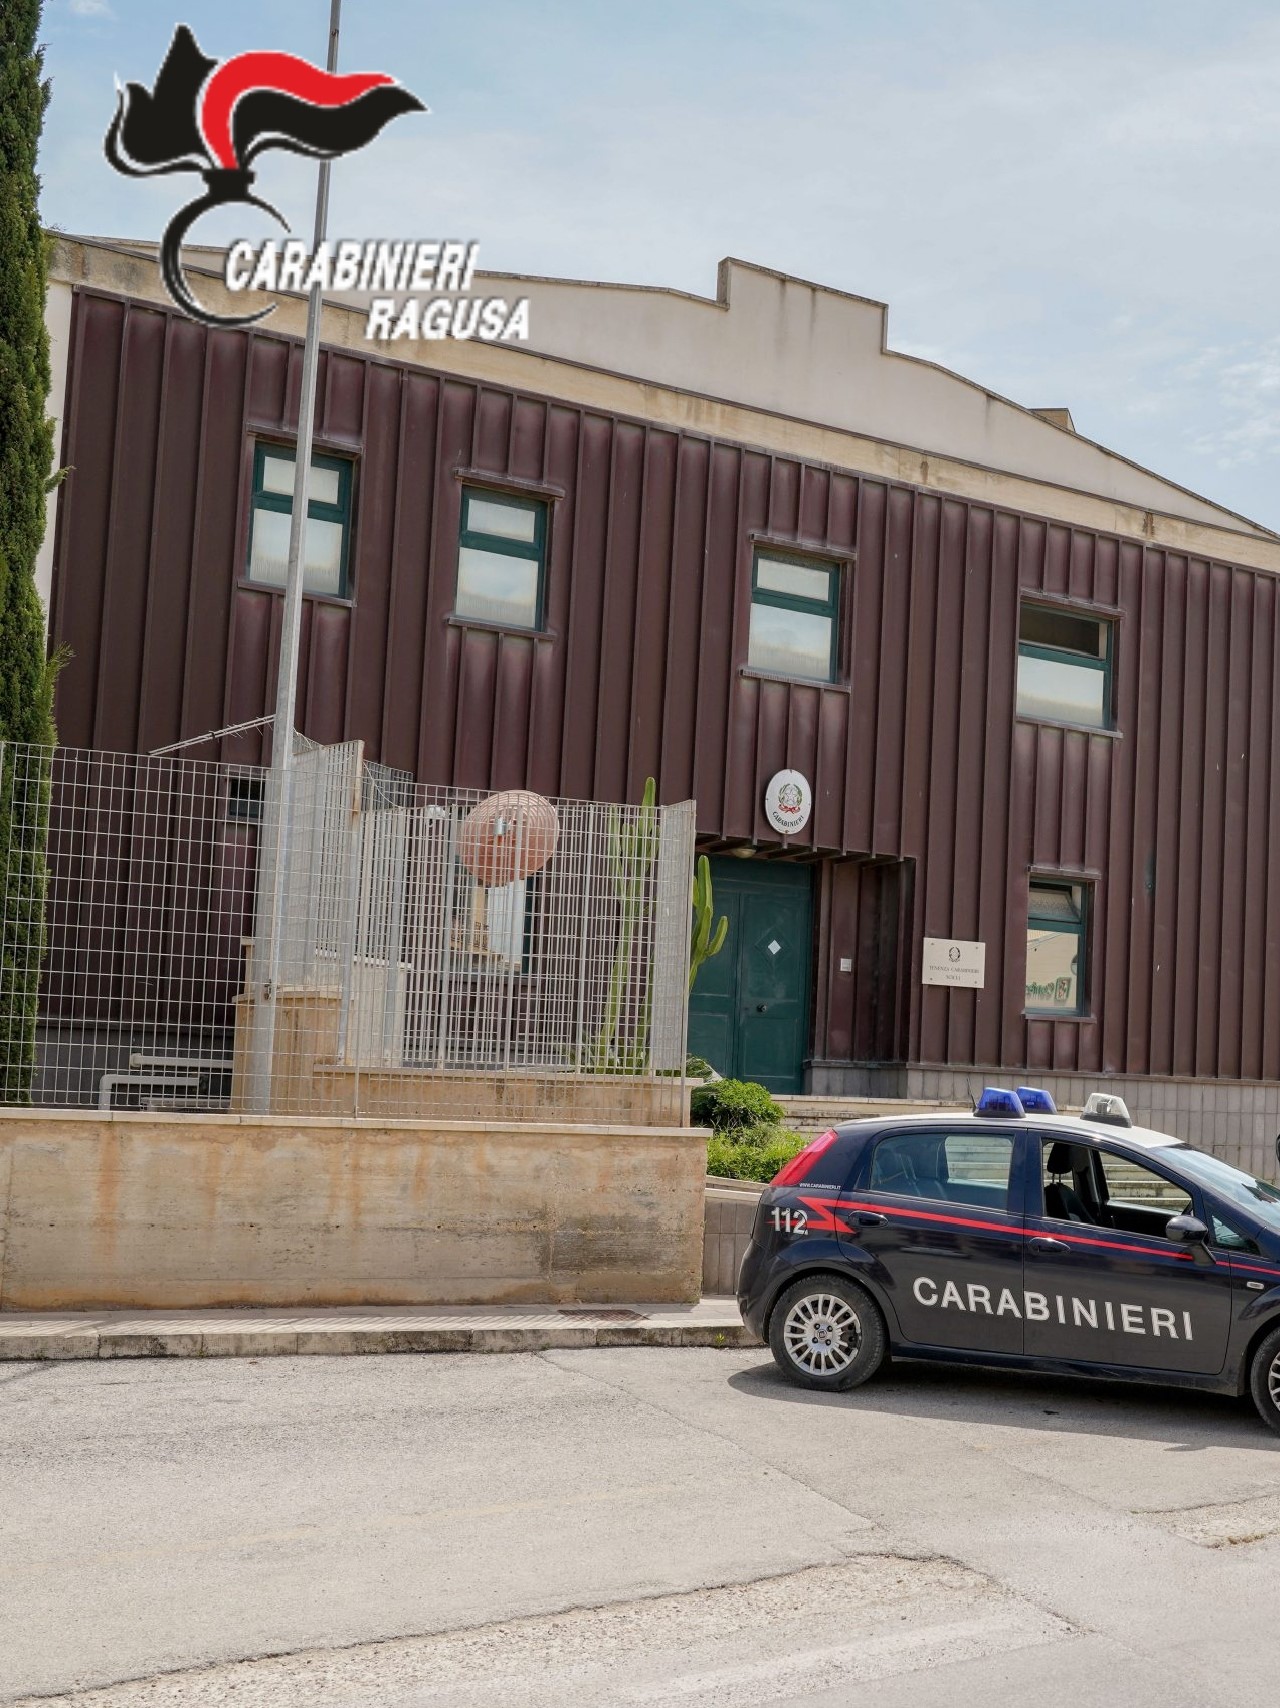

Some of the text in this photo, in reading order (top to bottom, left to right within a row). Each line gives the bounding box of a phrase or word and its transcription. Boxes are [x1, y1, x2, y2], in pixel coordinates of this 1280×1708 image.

[772, 811, 804, 828] CARABINIERI
[771, 1206, 809, 1236] 112
[912, 1276, 1194, 1341] CARABINIERI
